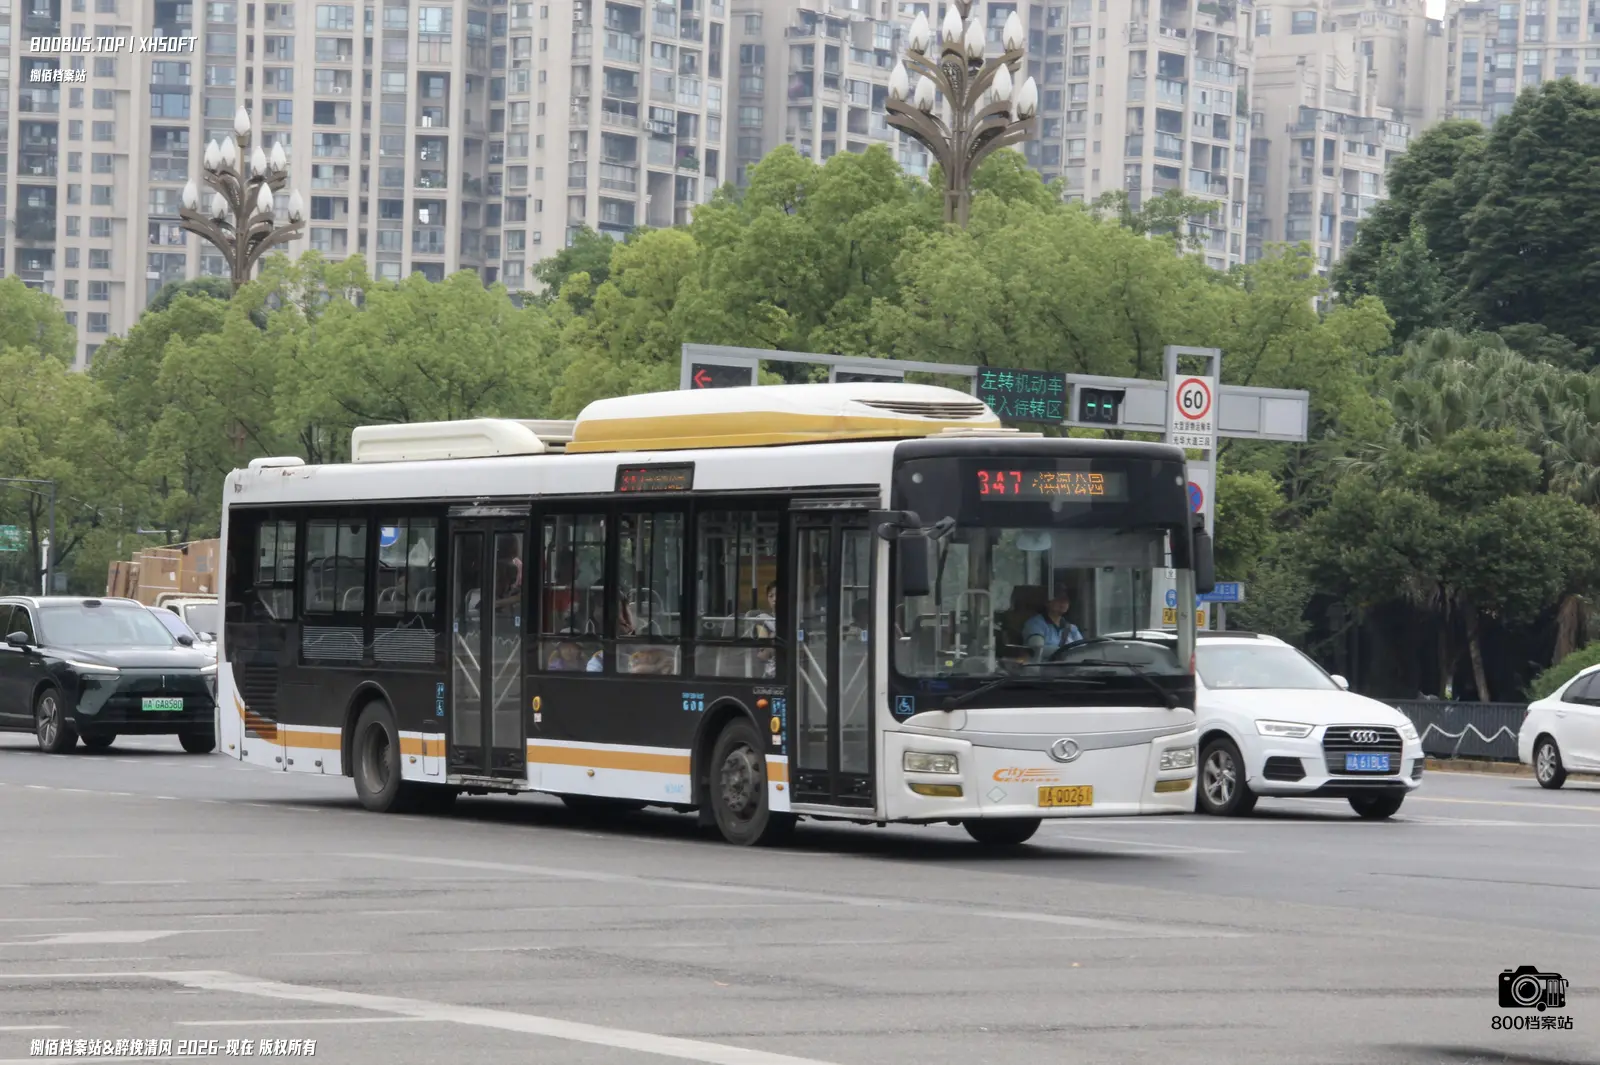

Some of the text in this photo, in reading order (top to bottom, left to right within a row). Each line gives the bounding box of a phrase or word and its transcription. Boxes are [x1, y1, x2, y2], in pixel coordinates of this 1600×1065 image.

[980, 370, 1063, 396] 左转机动车
[1184, 390, 1203, 409] 60
[977, 470, 1021, 495] 347
